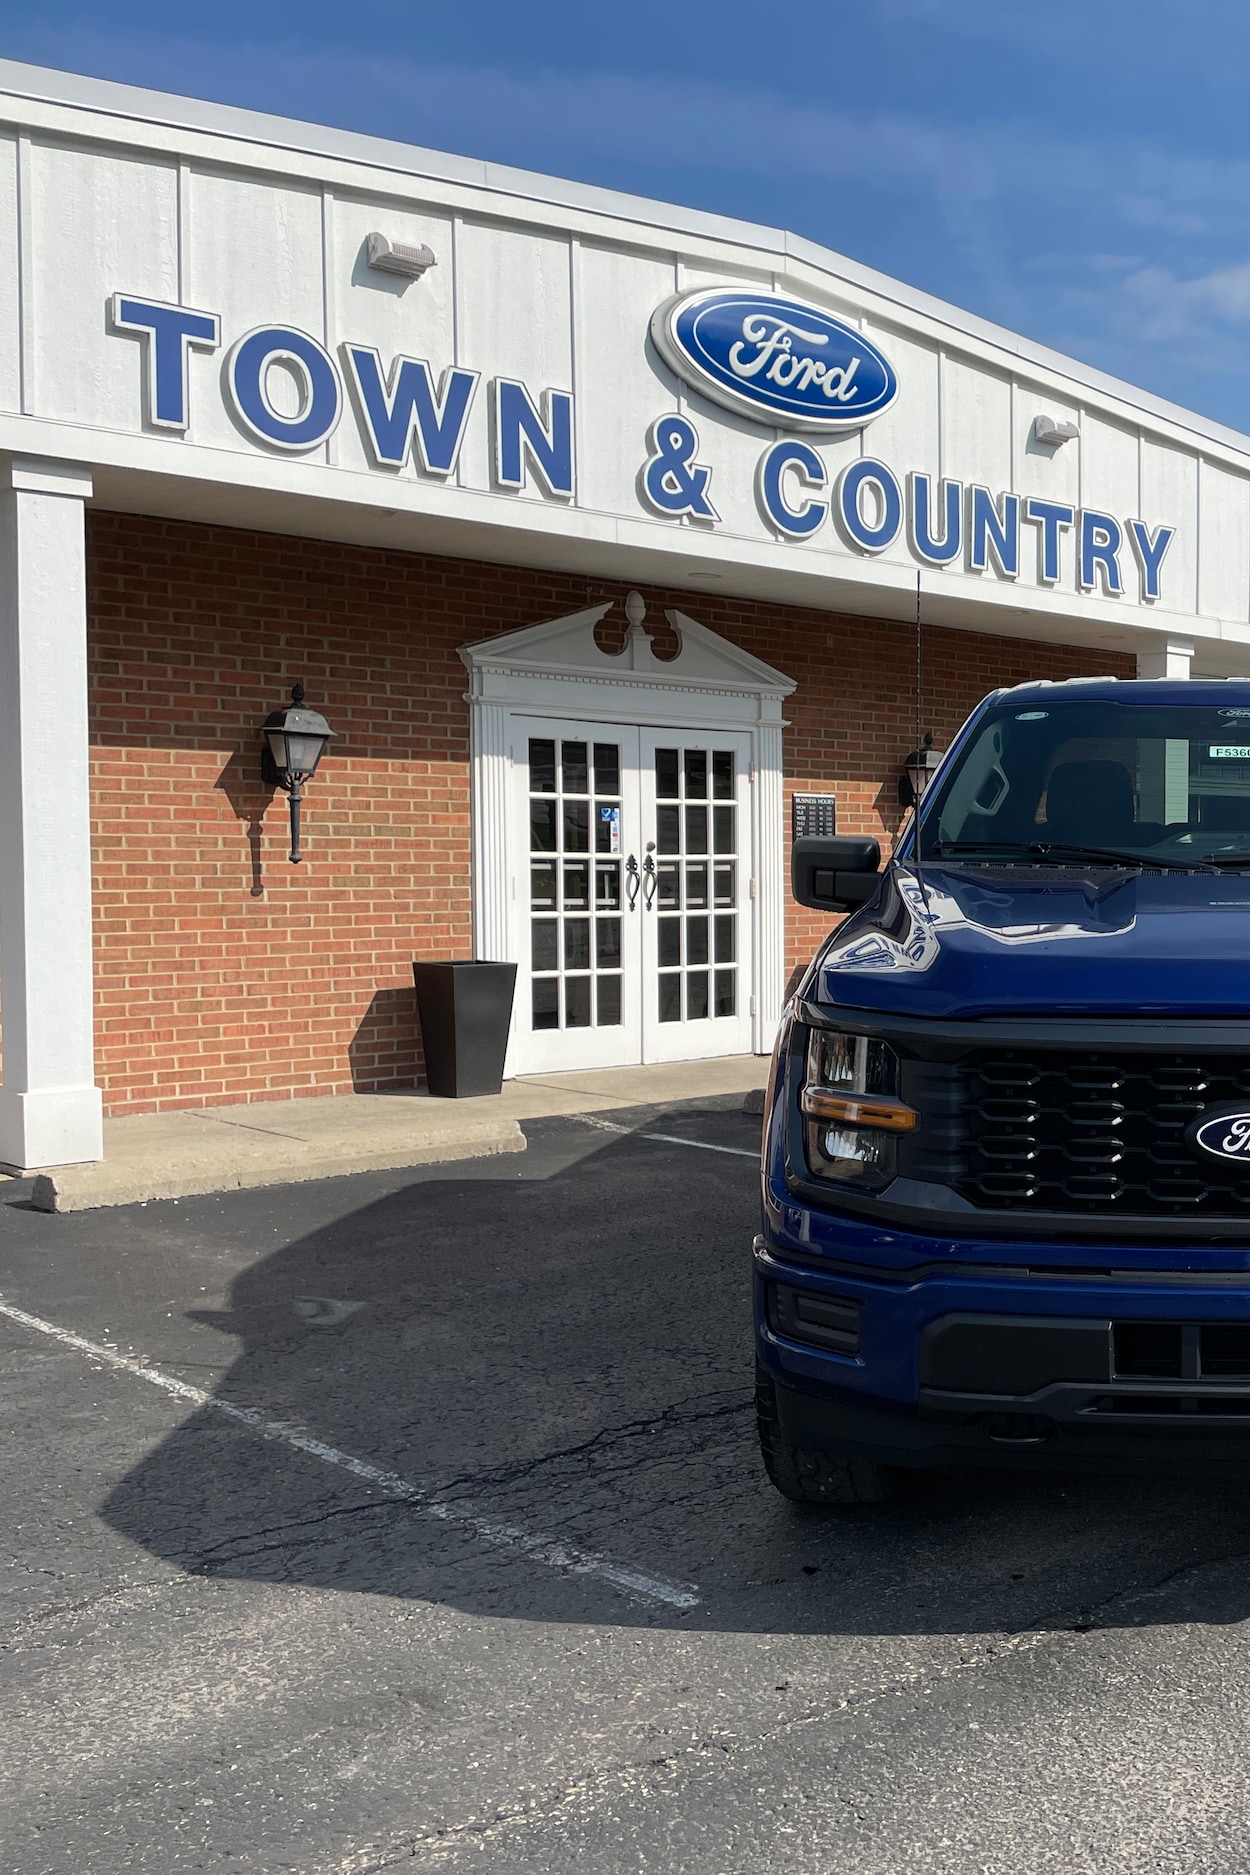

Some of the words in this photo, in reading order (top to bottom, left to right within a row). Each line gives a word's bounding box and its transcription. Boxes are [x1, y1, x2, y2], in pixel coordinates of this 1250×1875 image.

[112, 291, 577, 498] TOWN
[641, 411, 723, 523] &
[759, 438, 1177, 601] COUNTRY
[728, 313, 861, 403] Ford
